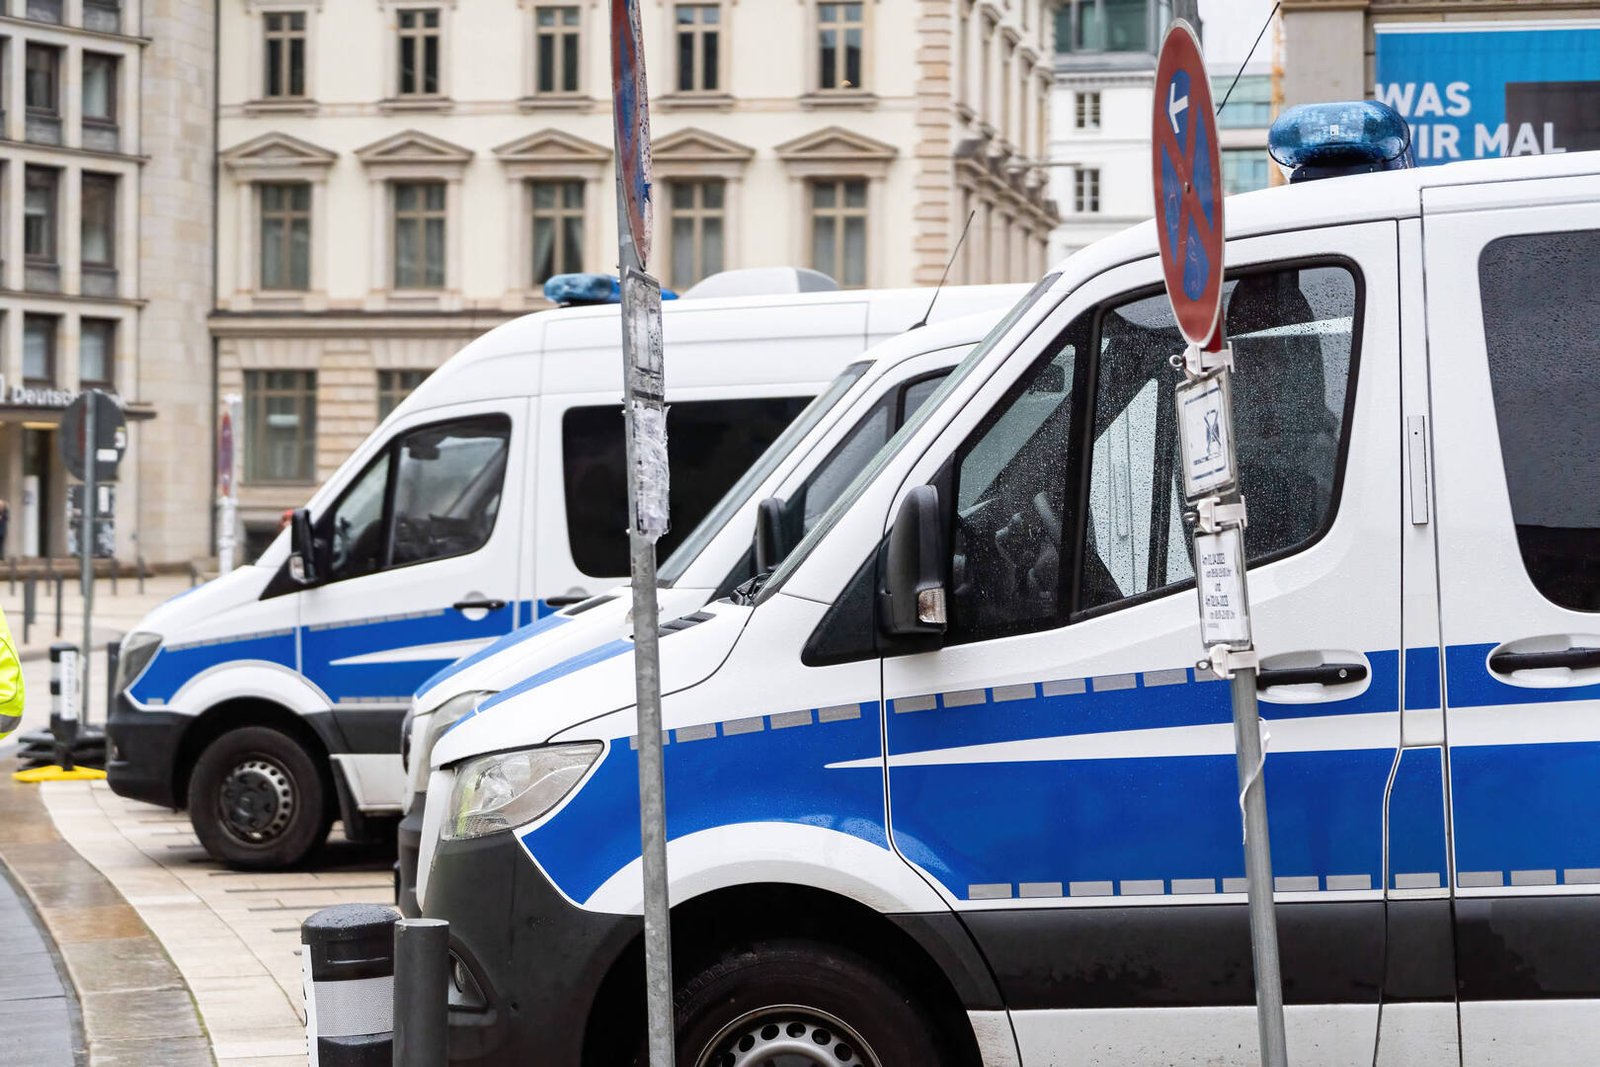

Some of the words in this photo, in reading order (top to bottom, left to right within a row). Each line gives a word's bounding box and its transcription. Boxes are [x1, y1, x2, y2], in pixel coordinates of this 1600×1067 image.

[1376, 82, 1471, 117] WAS
[1409, 124, 1461, 158] IR
[1474, 122, 1567, 158] MAL
